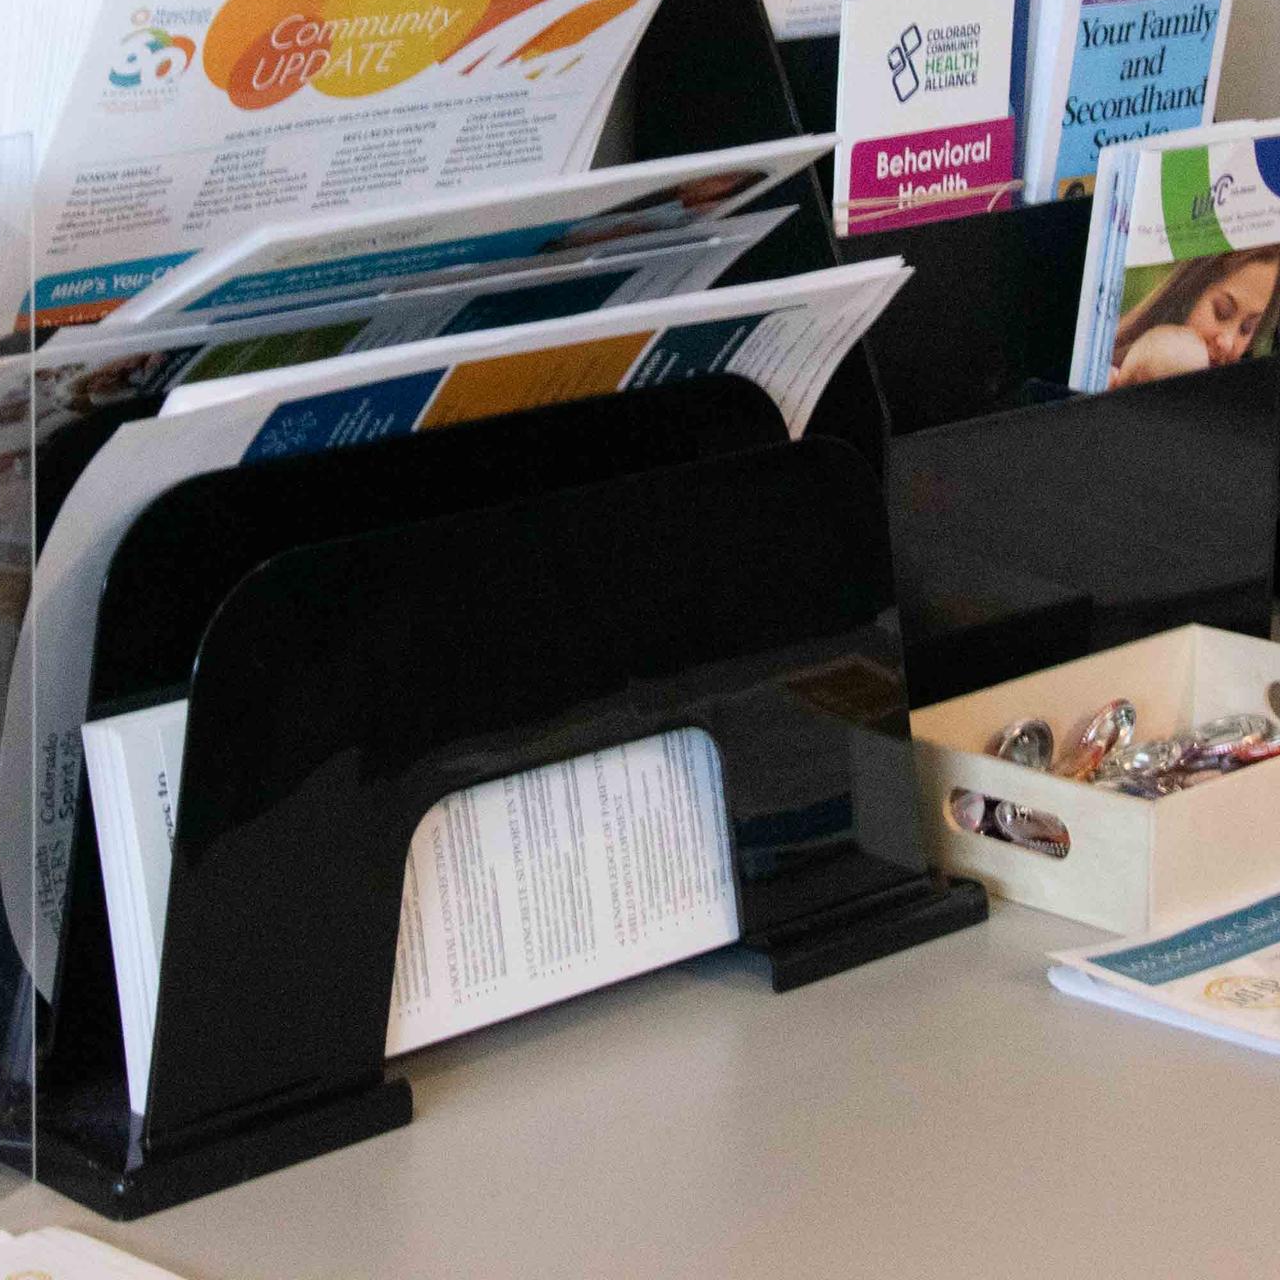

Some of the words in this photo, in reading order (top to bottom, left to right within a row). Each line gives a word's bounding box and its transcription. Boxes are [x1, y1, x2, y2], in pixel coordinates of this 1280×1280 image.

[271, 5, 462, 50] Community
[927, 23, 980, 41] COLORADO
[1082, 17, 1137, 48] Your
[1140, 4, 1217, 42] Family
[252, 39, 405, 91] UPDATE
[925, 52, 978, 74] HEALTH
[927, 40, 978, 54] COMMUNITY
[1120, 45, 1166, 81] and
[925, 72, 977, 91] ALLIANCE
[1064, 77, 1208, 126] Secondhand
[877, 133, 991, 179] Behavioral
